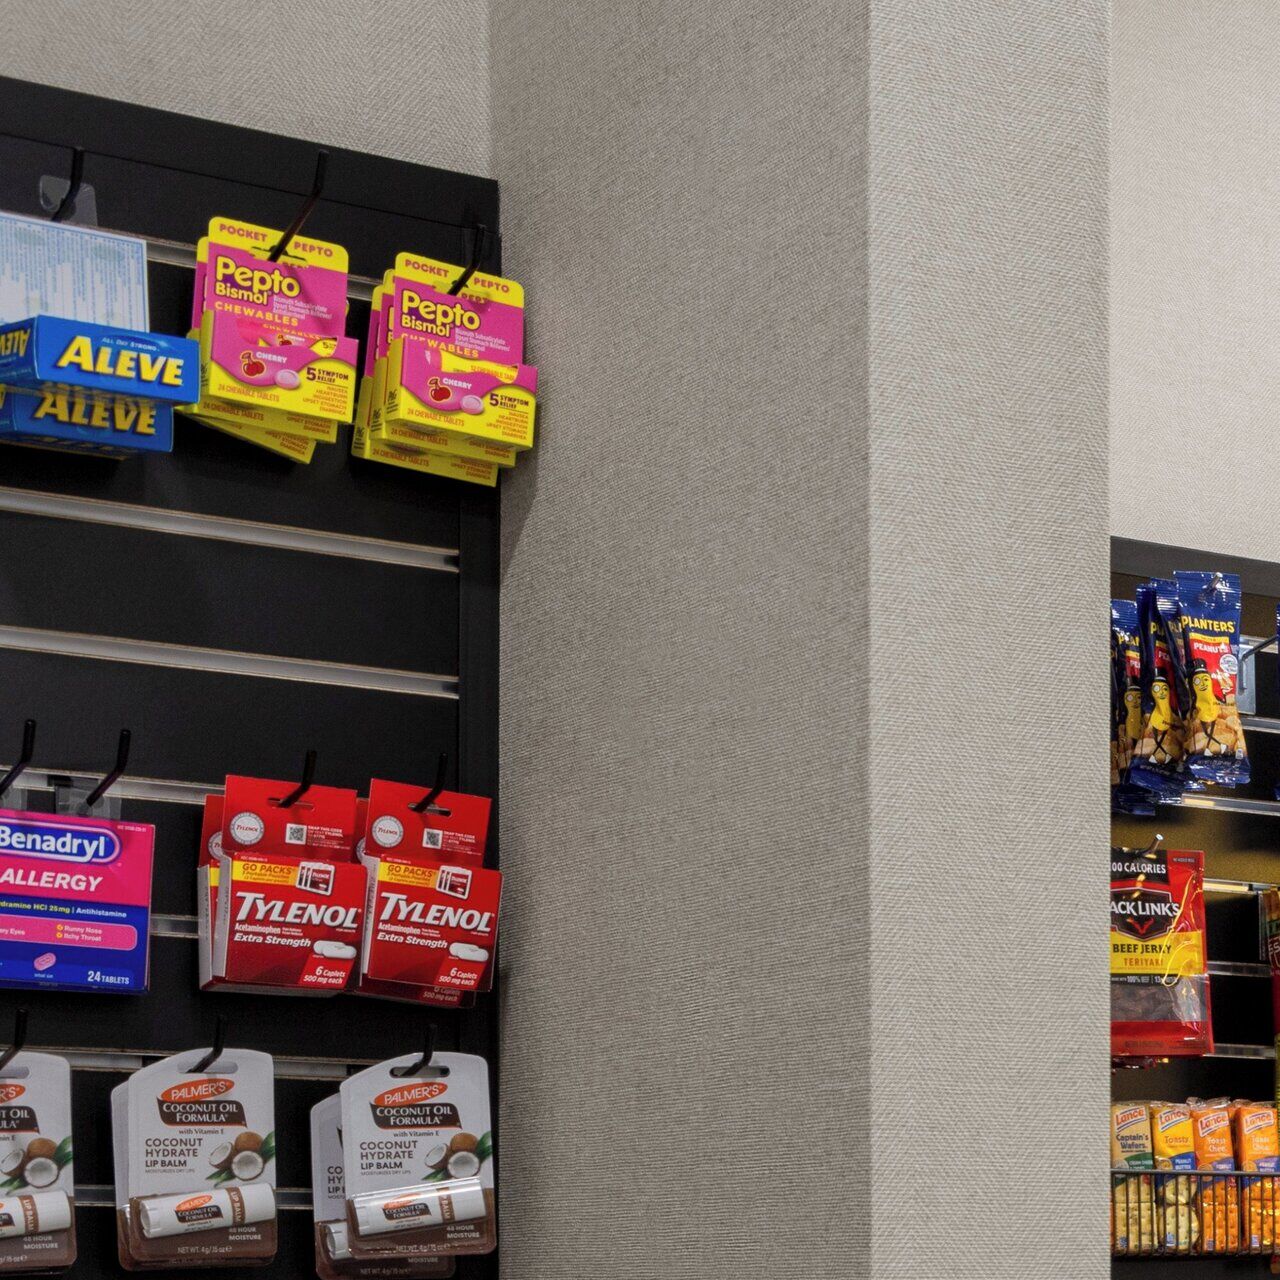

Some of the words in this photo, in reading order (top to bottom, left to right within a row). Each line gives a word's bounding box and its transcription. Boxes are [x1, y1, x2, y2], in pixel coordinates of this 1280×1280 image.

[219, 223, 268, 242] POCKET
[293, 241, 333, 257] PEPTO
[216, 256, 300, 297] Pepto
[405, 259, 450, 278] POCKET
[473, 277, 509, 293] PEPTO
[215, 282, 268, 305] Bismol
[214, 301, 299, 327] CHEWABLES
[402, 290, 480, 329] Pepto
[401, 314, 450, 337] Bismol
[57, 336, 184, 386] ALEVE
[256, 352, 287, 364] CHERRY
[306, 367, 316, 381] 5
[443, 378, 472, 390] CHERRY
[489, 393, 499, 407] 5
[34, 392, 156, 435] ALEVE
[1181, 616, 1235, 633] PLANTERS
[242, 864, 258, 872] GO
[260, 864, 293, 875] PACKS
[388, 864, 401, 874] GO
[402, 866, 433, 878] PACKS
[1124, 862, 1166, 874] CALORIES
[0, 868, 104, 892] ALLERGY
[234, 892, 358, 928] TYLENOL
[380, 892, 492, 932] TYLENOL
[235, 922, 281, 935] Acetaminophen
[378, 922, 421, 936] Acetaminophen
[234, 933, 262, 944] Extra
[265, 935, 311, 948] Strength
[378, 932, 404, 944] Extra
[406, 936, 448, 949] Strength
[1113, 943, 1138, 953] BEEF
[1141, 944, 1171, 954] JERKY
[1124, 957, 1164, 966] TERIYAKI
[87, 970, 100, 982] 24
[102, 976, 129, 984] TABLETS
[316, 966, 322, 976] 6
[323, 969, 346, 978] Caplets
[170, 1081, 227, 1100] PALMER'S
[384, 1085, 439, 1104] PALMER'S
[163, 1102, 218, 1113] COCONUT
[220, 1103, 238, 1113] OIL
[376, 1107, 431, 1116] COCONUT
[433, 1106, 452, 1115] OIL
[176, 1112, 225, 1122] FORMULA
[390, 1115, 440, 1125] FORMULA
[1115, 1108, 1145, 1126] Lance
[1200, 1114, 1228, 1130] Lance
[145, 1138, 203, 1147] COCONUT
[360, 1140, 418, 1150] COCONUT
[1116, 1134, 1149, 1143] Captain's
[1120, 1140, 1145, 1150] Wafers
[1164, 1136, 1190, 1144] Toasty
[145, 1148, 198, 1157] HYDRATE
[360, 1150, 414, 1160] HYDRATE
[160, 1159, 187, 1167] BALM
[361, 1162, 374, 1170] LIP
[376, 1162, 403, 1170] BALM
